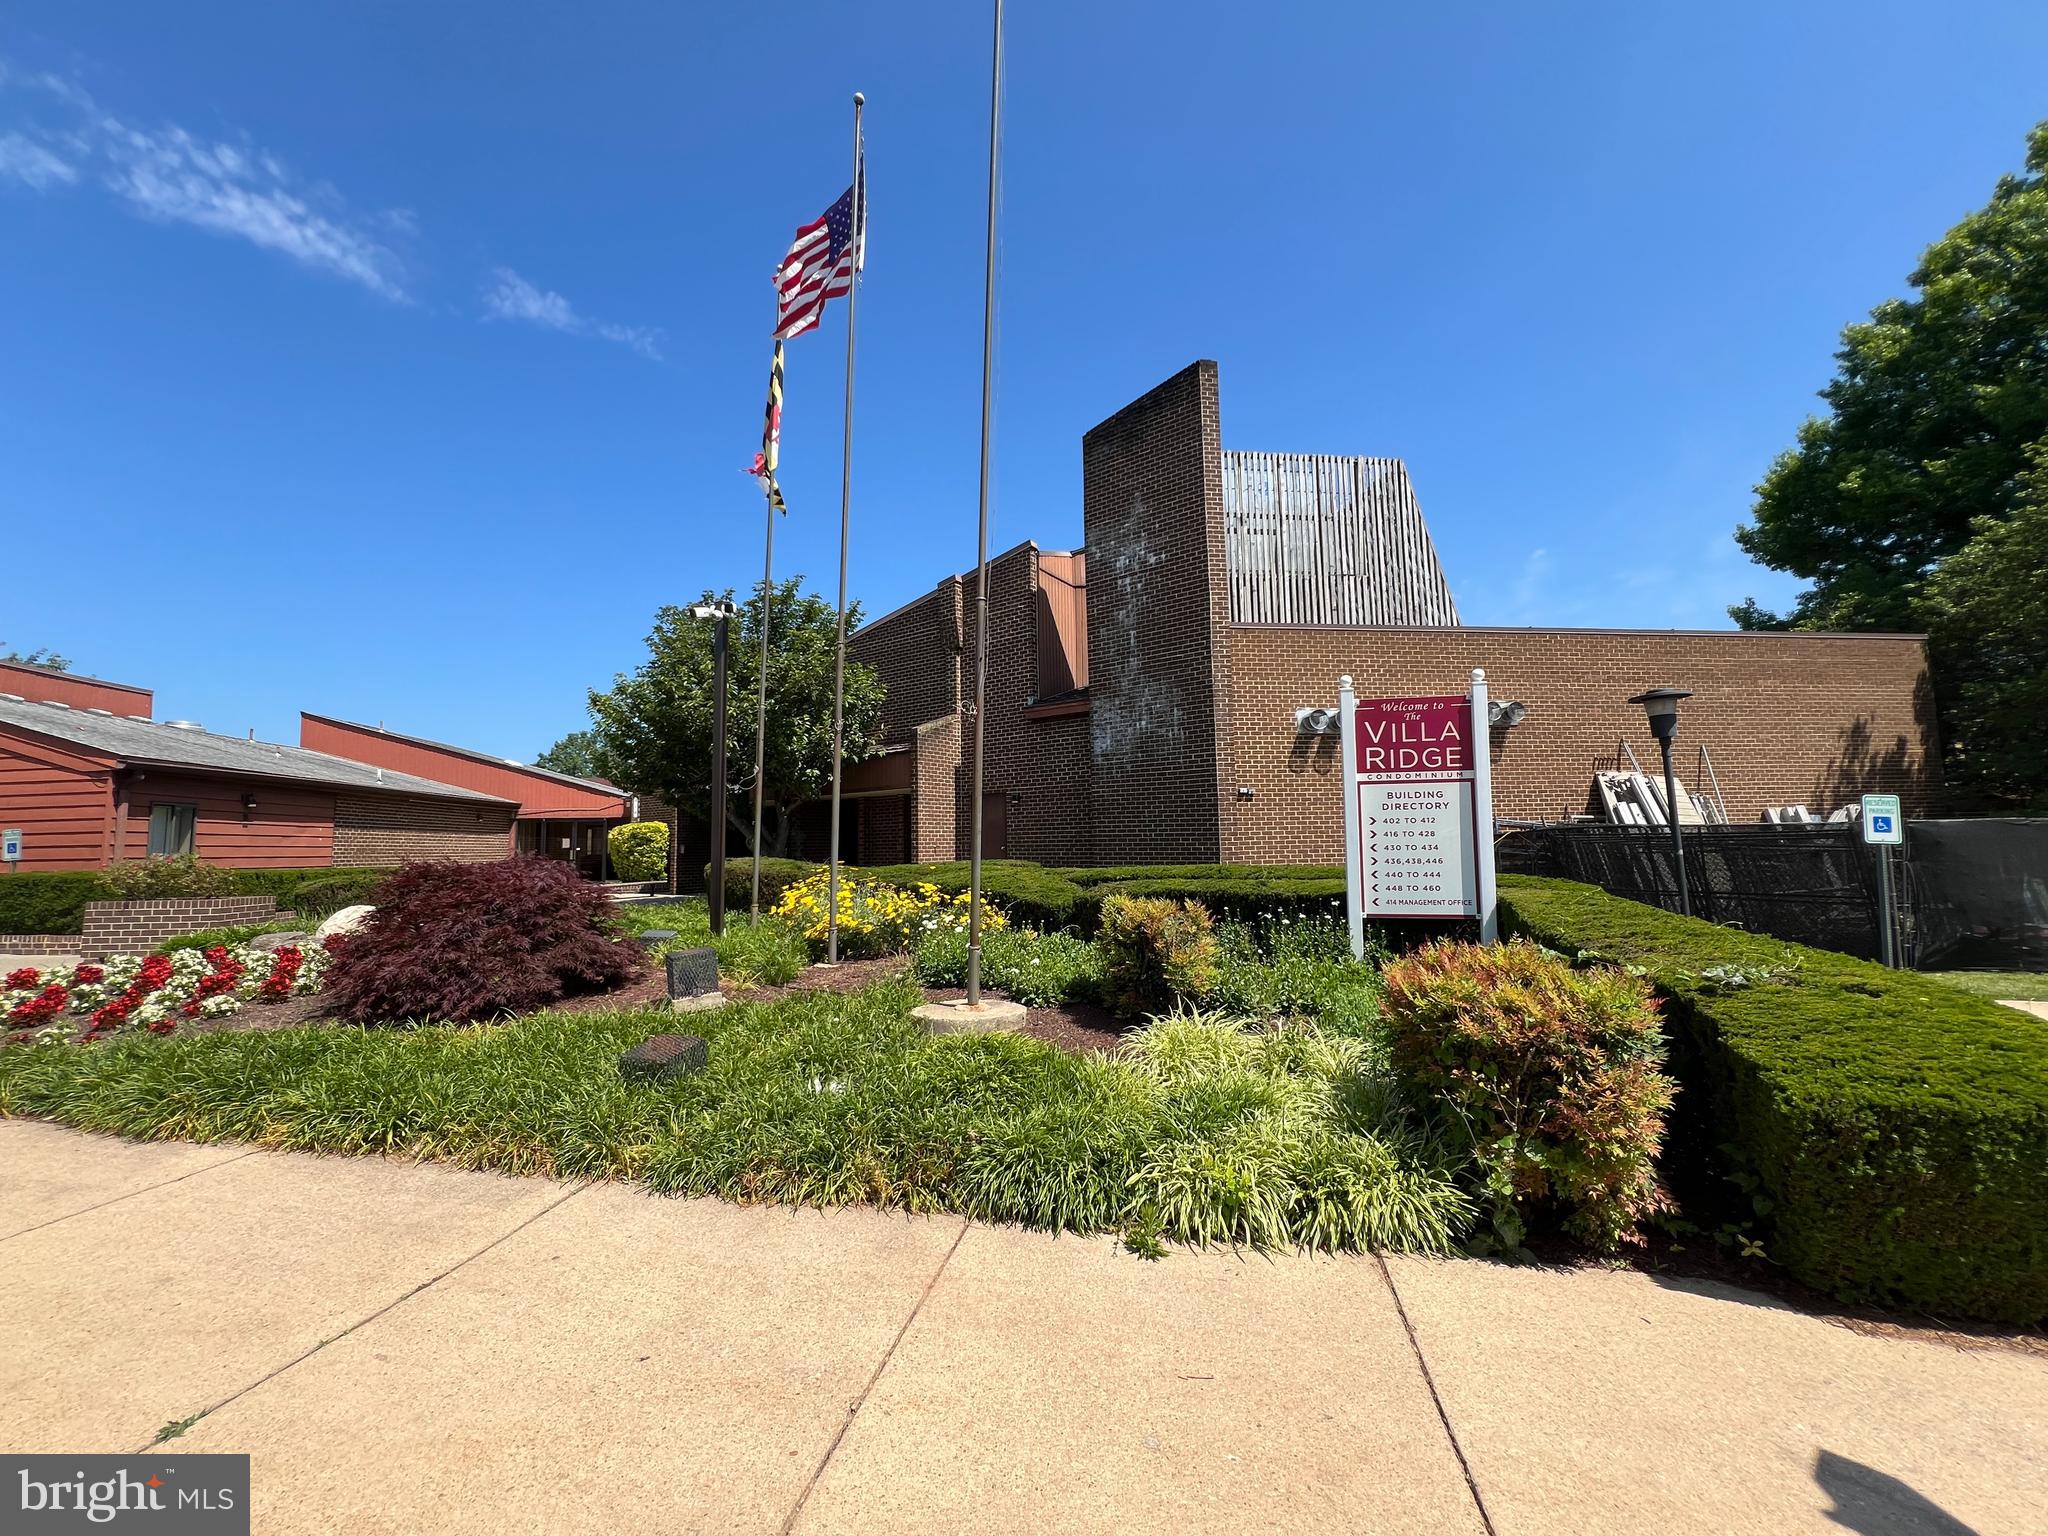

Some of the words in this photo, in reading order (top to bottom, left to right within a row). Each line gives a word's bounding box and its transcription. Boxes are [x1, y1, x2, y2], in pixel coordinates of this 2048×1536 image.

[1381, 702, 1428, 712] Welcome
[1433, 702, 1444, 710] to
[1404, 712, 1421, 721] The
[1364, 721, 1460, 744] VILLA
[1366, 747, 1463, 770] RIDGE
[1367, 772, 1464, 780] CONDOMINIUM
[1387, 791, 1444, 800] BUILDING
[1382, 802, 1450, 811] DIRECTORY
